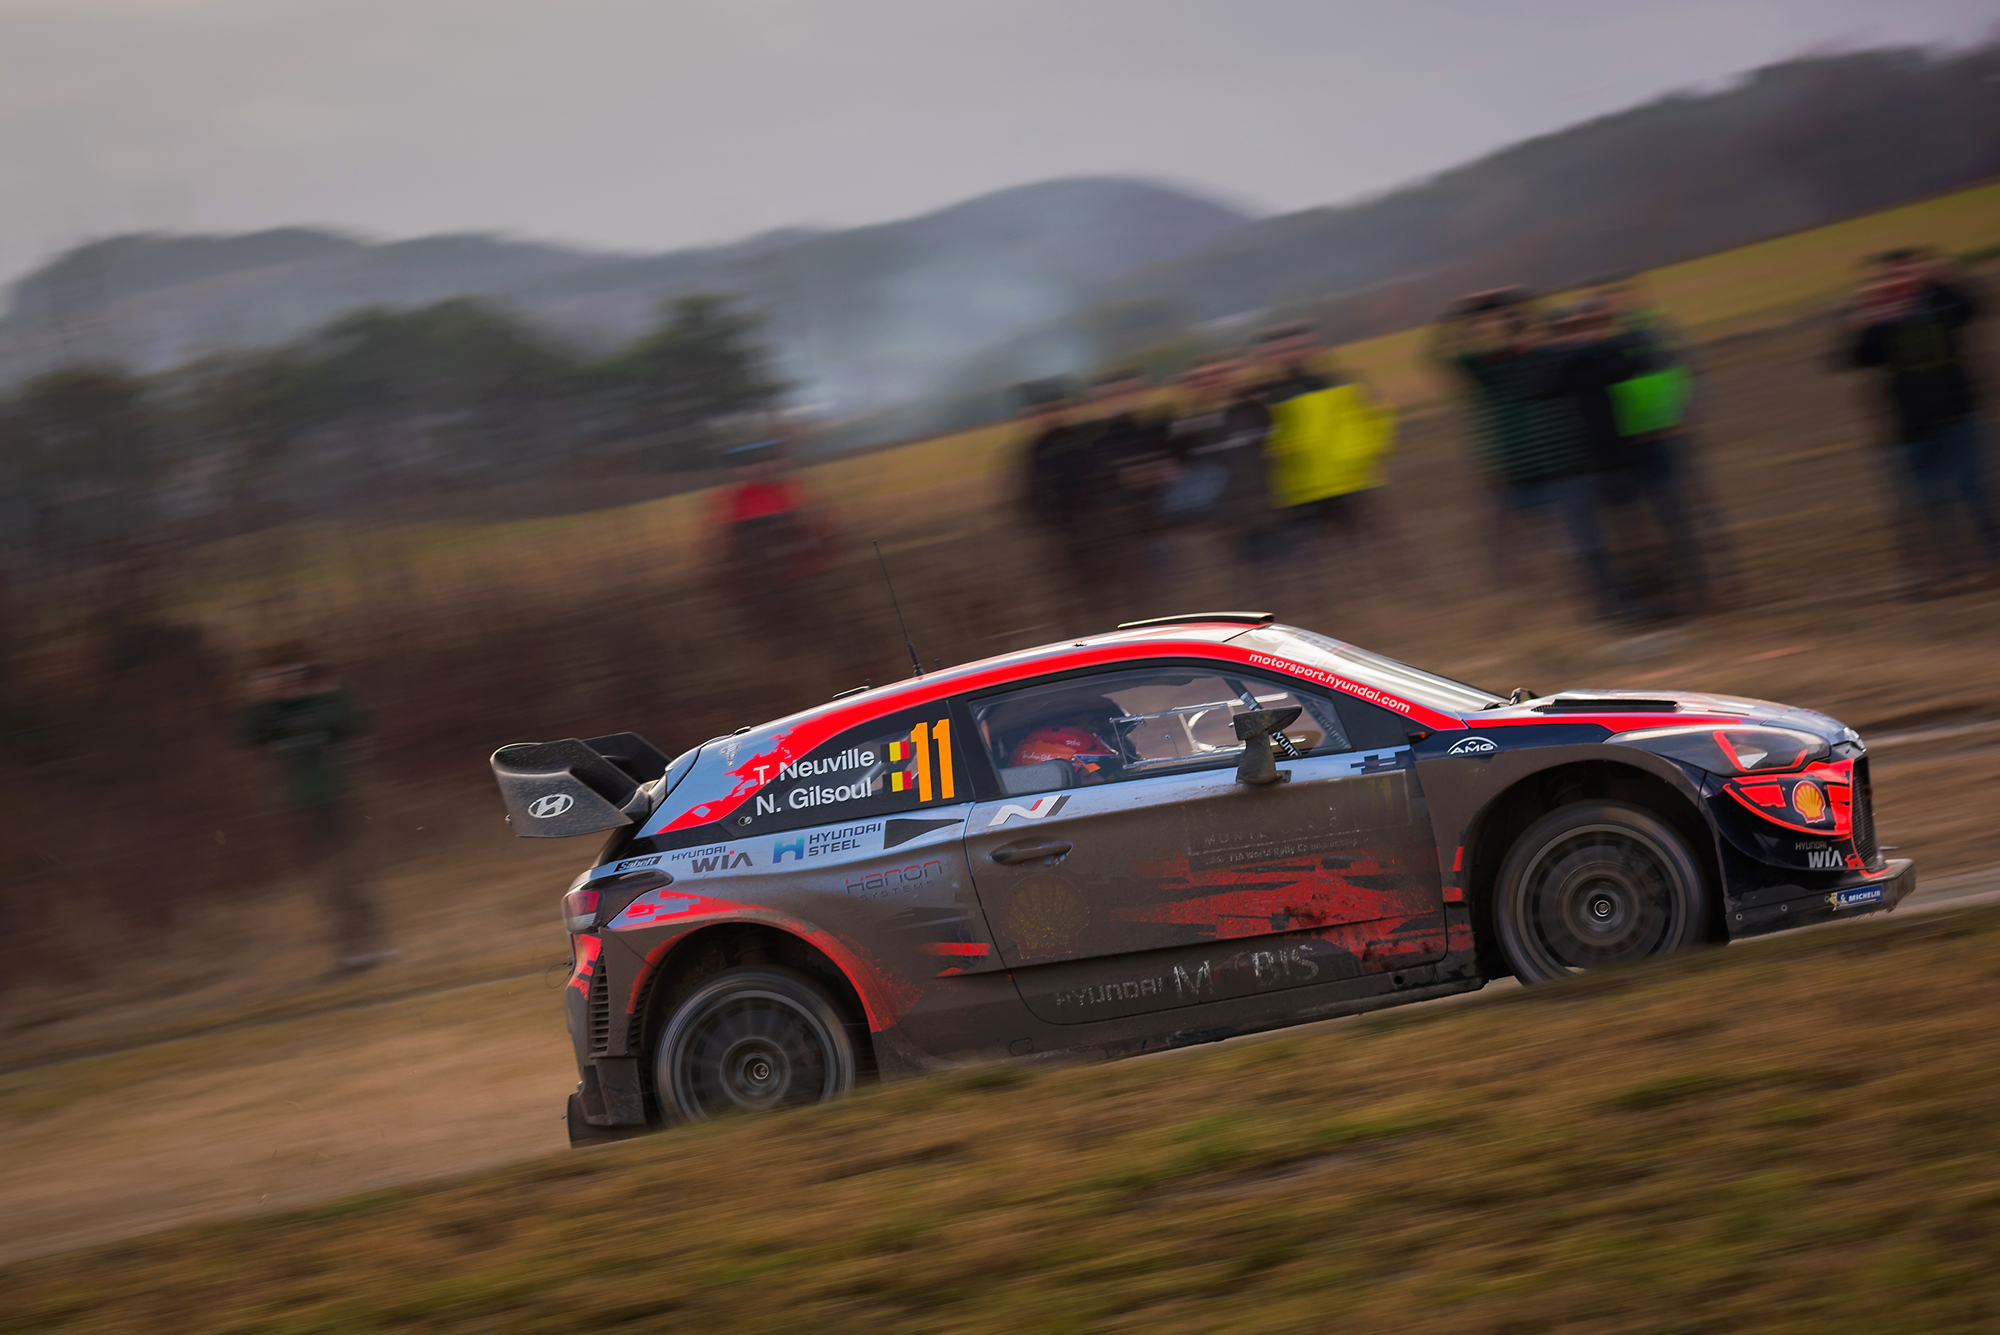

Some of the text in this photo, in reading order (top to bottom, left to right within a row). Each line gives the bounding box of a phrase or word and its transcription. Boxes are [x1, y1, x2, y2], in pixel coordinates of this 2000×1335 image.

[1249, 653, 1411, 714] motorsport.hyundai.com
[1449, 742, 1495, 755] AMG
[753, 748, 875, 785] T. Neuville
[910, 719, 955, 803] 11
[756, 777, 873, 816] N. Gilsoul
[808, 822, 882, 845] HYUNDAI
[671, 845, 727, 861] HYUNDAI
[808, 838, 861, 857] STEEL
[1795, 841, 1828, 851] HYUNDAI
[692, 850, 753, 874] WIA
[1808, 847, 1844, 869] WIA
[859, 880, 935, 901] SYSTEMS
[1848, 890, 1881, 902] MICHELIN
[1173, 944, 1320, 1000] MBIS
